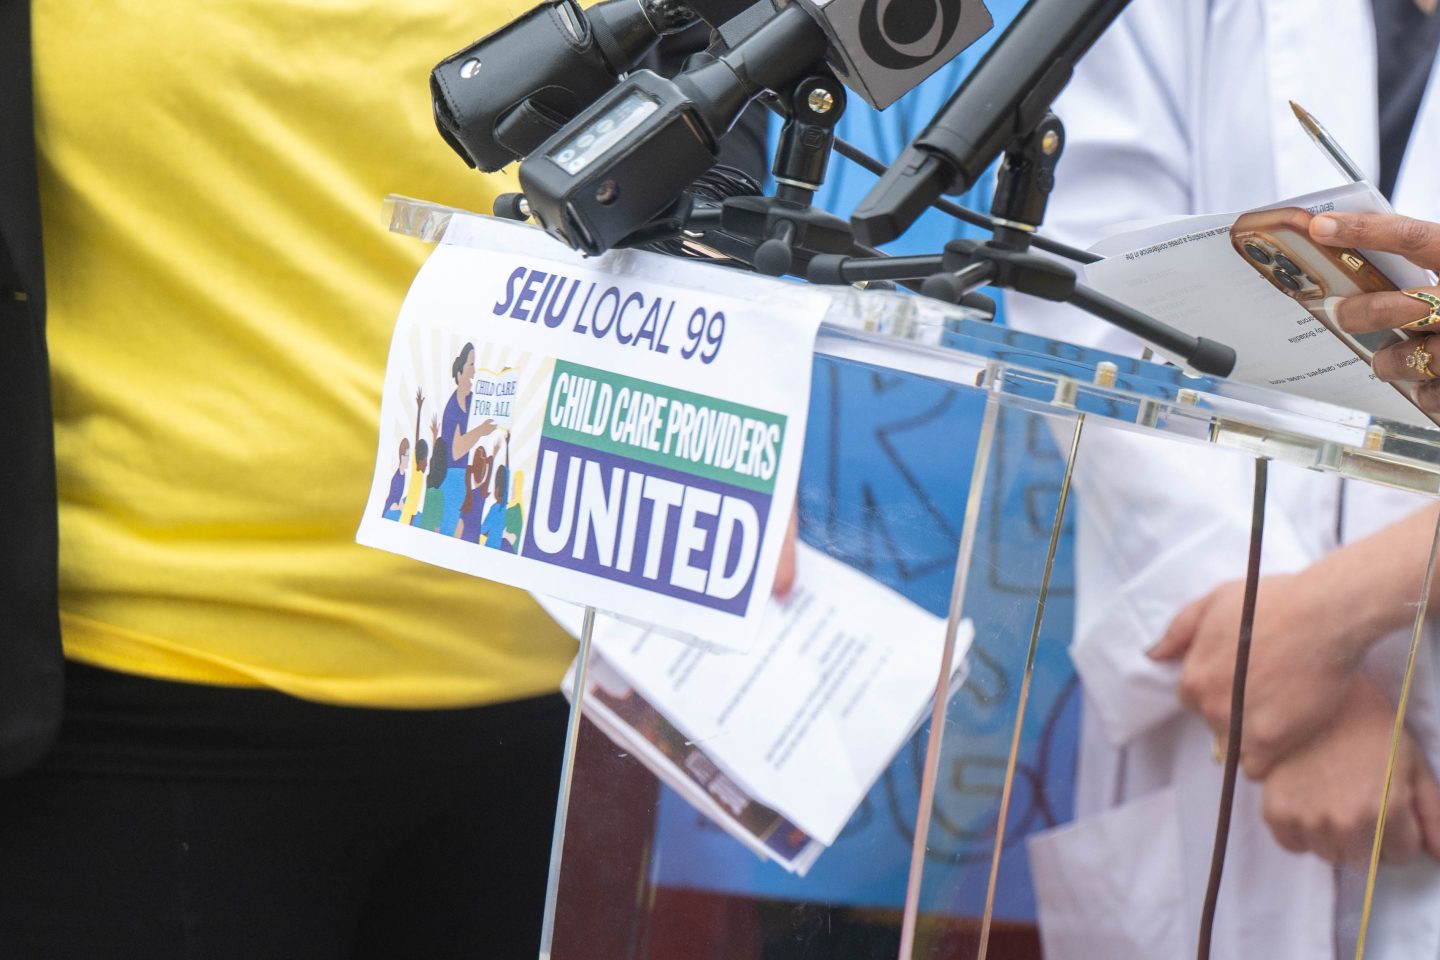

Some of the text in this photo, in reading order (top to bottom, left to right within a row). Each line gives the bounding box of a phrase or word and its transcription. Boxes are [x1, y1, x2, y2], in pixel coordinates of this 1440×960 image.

[1139, 243, 1168, 257] conference
[1167, 237, 1183, 248] press
[492, 266, 726, 365] SEIU LOCAL 99
[475, 379, 518, 396] CHILD CARE
[473, 399, 511, 417] FOR ALL
[549, 371, 781, 481] CHILD CARE PROVIDERS
[532, 449, 761, 601] UNITED
